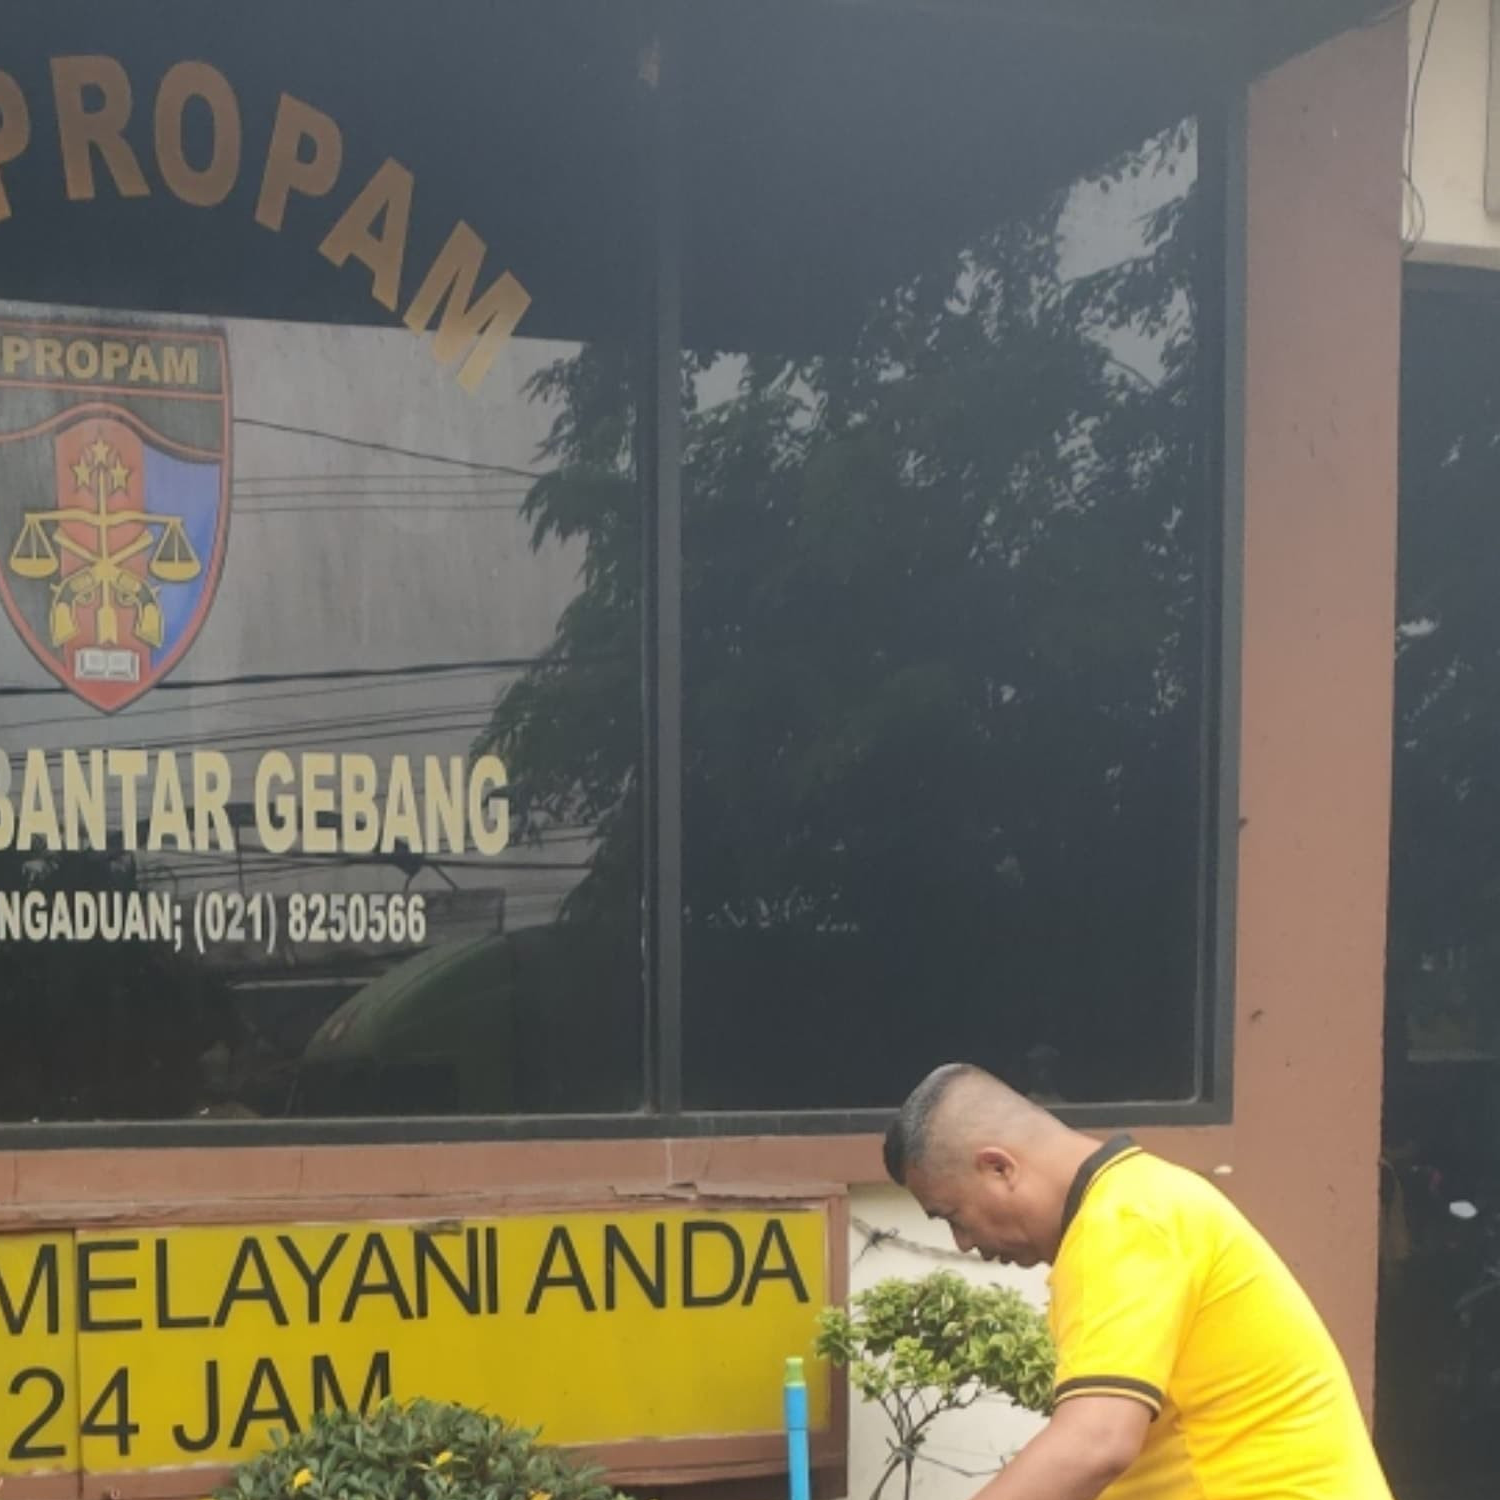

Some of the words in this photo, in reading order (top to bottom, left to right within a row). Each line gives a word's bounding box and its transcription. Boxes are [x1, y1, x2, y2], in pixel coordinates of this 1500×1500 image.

[1, 334, 200, 385] PROPAM
[254, 748, 510, 857] GEBANG
[193, 890, 277, 954] (021)
[286, 892, 427, 945] 8250566
[524, 1218, 810, 1315] ANDA
[7, 1366, 140, 1461] 24
[172, 1351, 392, 1453] JAM
